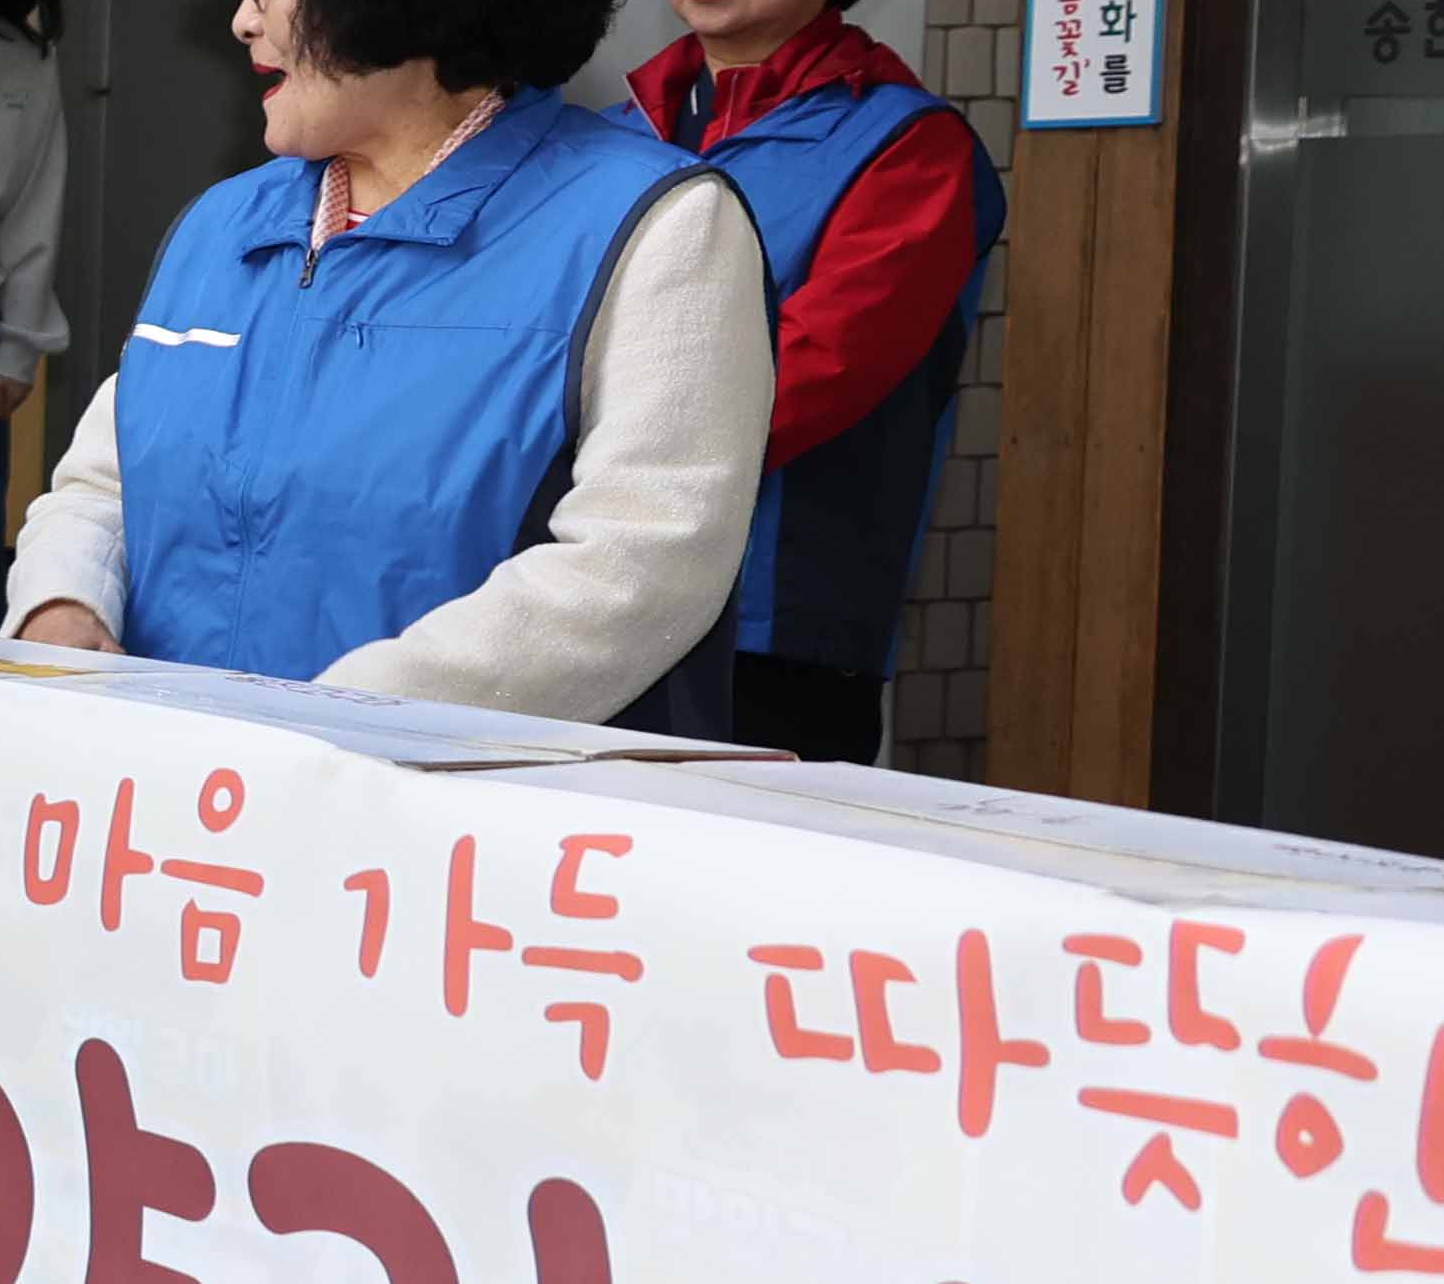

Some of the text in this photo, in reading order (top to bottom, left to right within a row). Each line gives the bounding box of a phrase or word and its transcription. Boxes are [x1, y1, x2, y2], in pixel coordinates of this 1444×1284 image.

[24, 766, 265, 986] 마음
[343, 833, 645, 1083] 가득
[747, 919, 1444, 1276] 따뜻한
